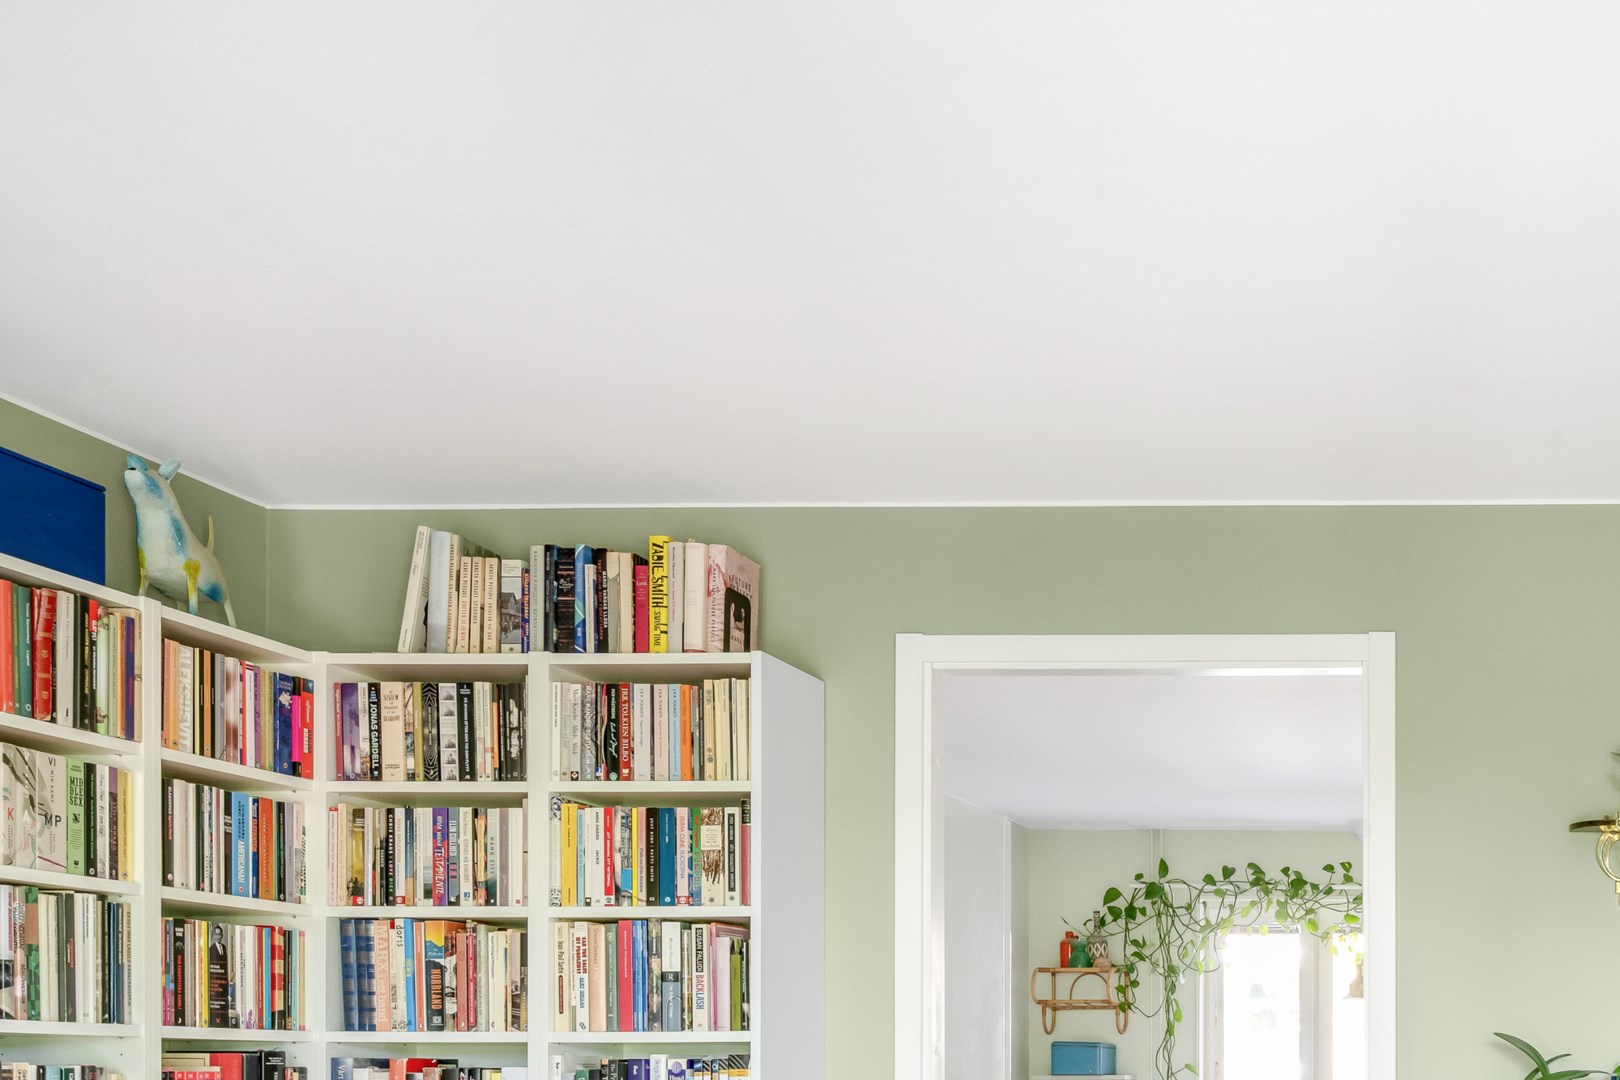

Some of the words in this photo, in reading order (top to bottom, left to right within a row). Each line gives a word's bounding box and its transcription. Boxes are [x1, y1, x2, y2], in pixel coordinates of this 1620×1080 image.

[651, 542, 668, 572] ZADIE
[651, 576, 668, 608] SMITH
[653, 634, 662, 647] TIME
[621, 688, 629, 700] JRR
[370, 703, 378, 731] JONAS
[621, 702, 629, 737] TOLKIEN
[371, 732, 379, 768] GARDELL
[621, 738, 629, 761] BILBO
[449, 820, 457, 832] ELIN
[396, 925, 404, 947] doris
[431, 969, 442, 1010] NORRLAND
[696, 974, 704, 1009] BACKLASH
